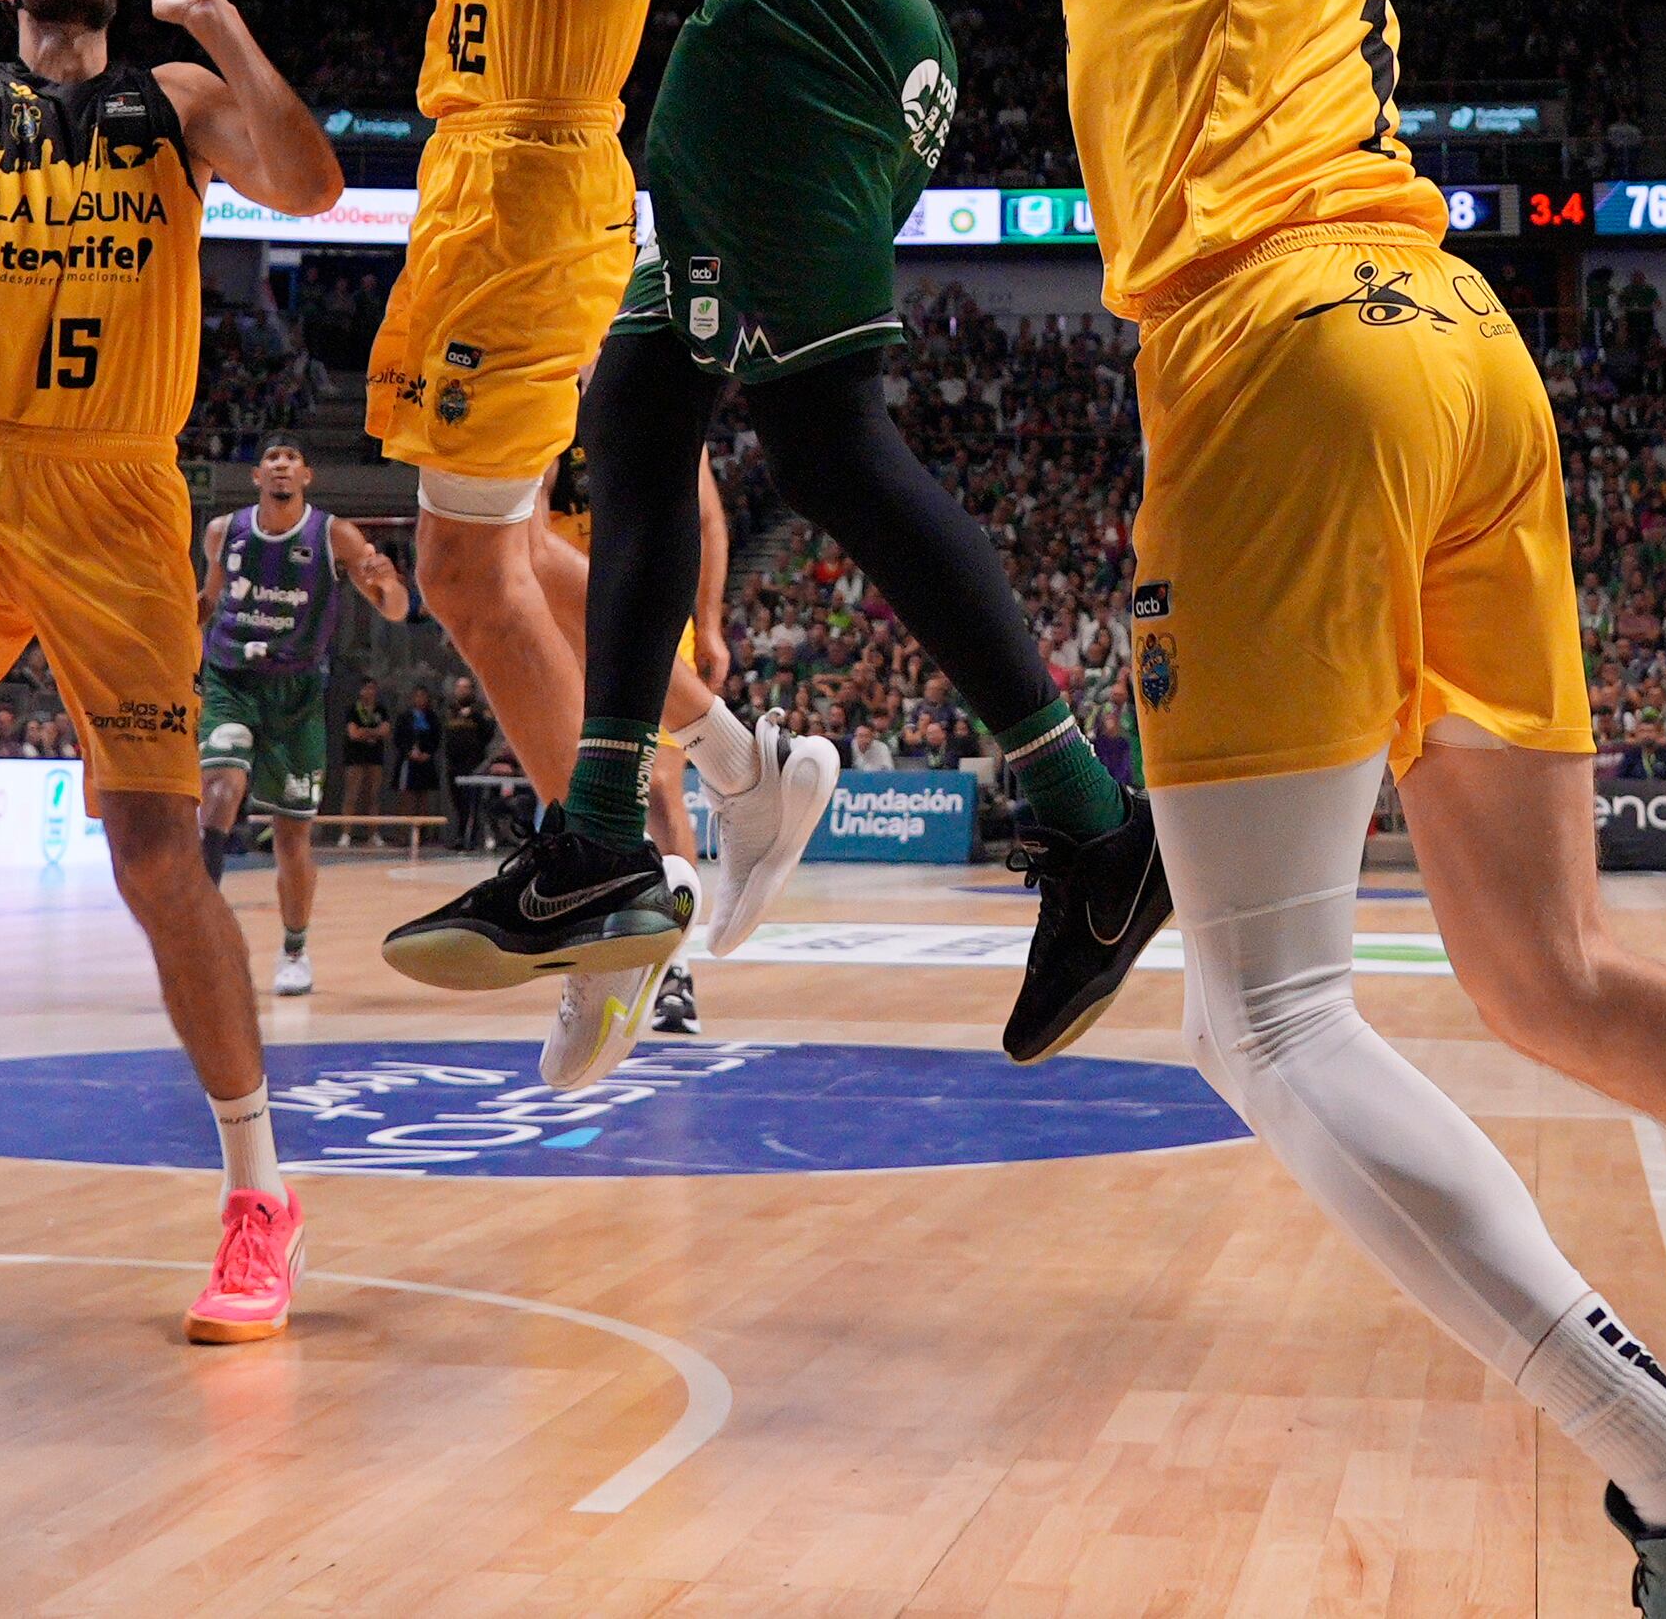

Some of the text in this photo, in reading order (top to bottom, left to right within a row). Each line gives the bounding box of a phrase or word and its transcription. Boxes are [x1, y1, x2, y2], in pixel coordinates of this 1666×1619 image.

[447, 3, 488, 76] 42
[44, 190, 168, 227] LAGUNA
[1530, 192, 1586, 226] 3.4
[691, 267, 712, 280] acb
[36, 317, 103, 390] 15
[448, 351, 471, 366] acb
[252, 585, 309, 606] Unicaja
[1134, 597, 1161, 616] acb
[832, 787, 963, 815] Fundación
[829, 814, 926, 843] Unicaja
